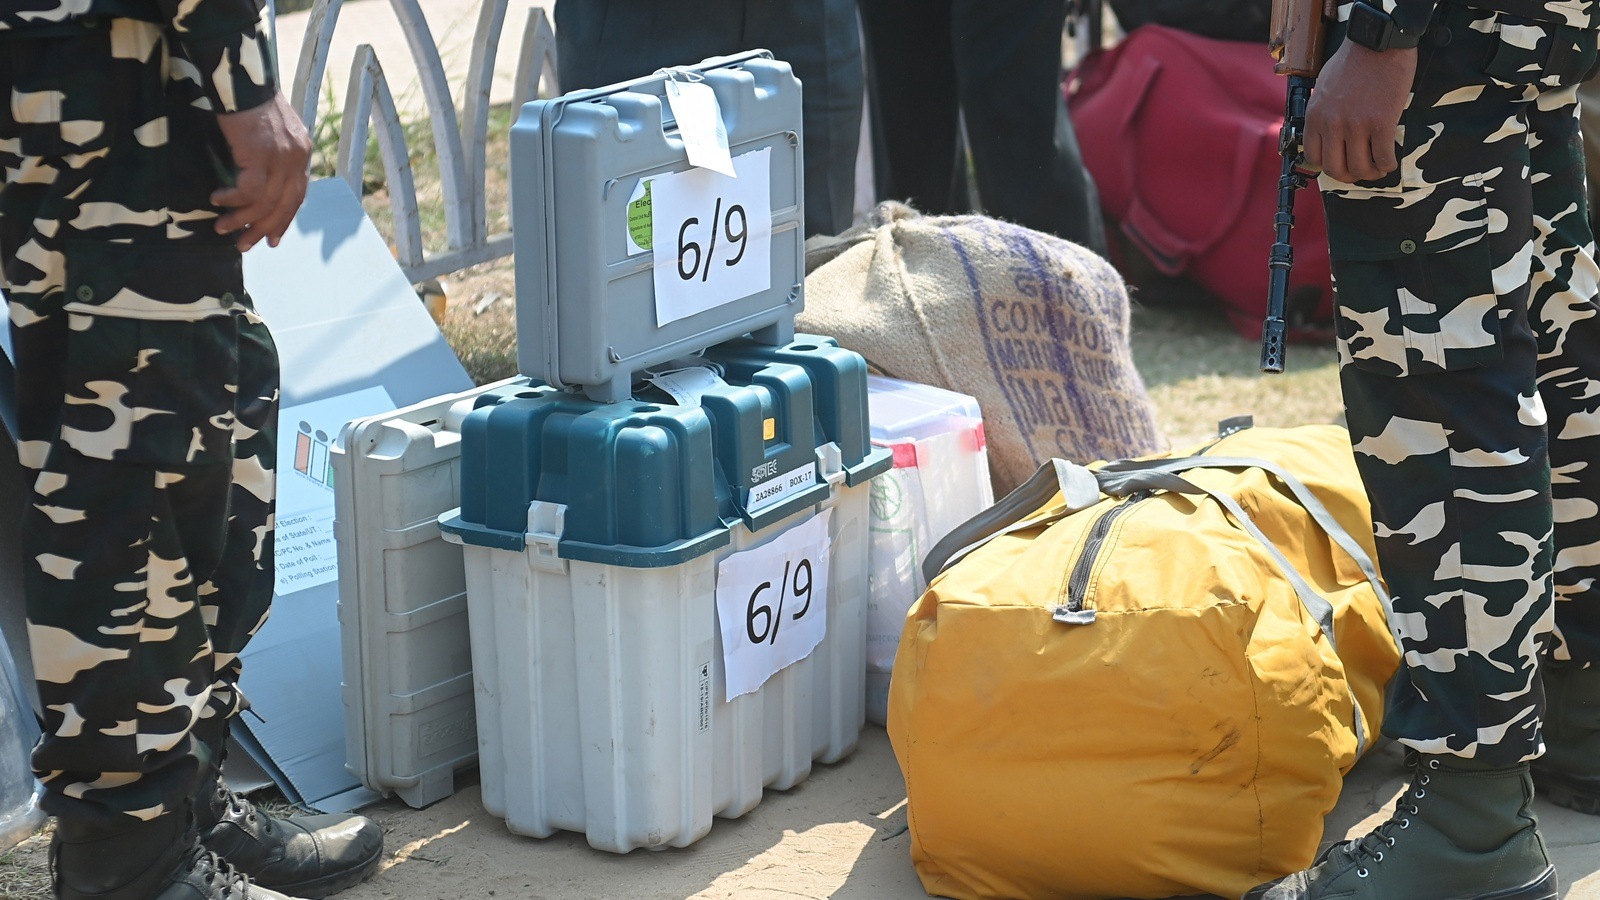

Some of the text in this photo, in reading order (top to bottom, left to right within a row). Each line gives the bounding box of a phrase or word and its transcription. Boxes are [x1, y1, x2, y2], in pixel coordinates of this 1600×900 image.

[677, 197, 748, 283] 6/9
[789, 470, 812, 488] BOX-17
[280, 516, 308, 527] Election
[281, 533, 290, 541] of
[289, 526, 317, 539] State/UT
[292, 545, 306, 553] No.
[311, 538, 331, 547] Name
[279, 562, 296, 570] Date
[296, 558, 304, 566] of
[303, 554, 318, 563] Poll
[288, 570, 314, 581] Polling
[312, 564, 337, 575] Station
[746, 558, 813, 645] 6/9
